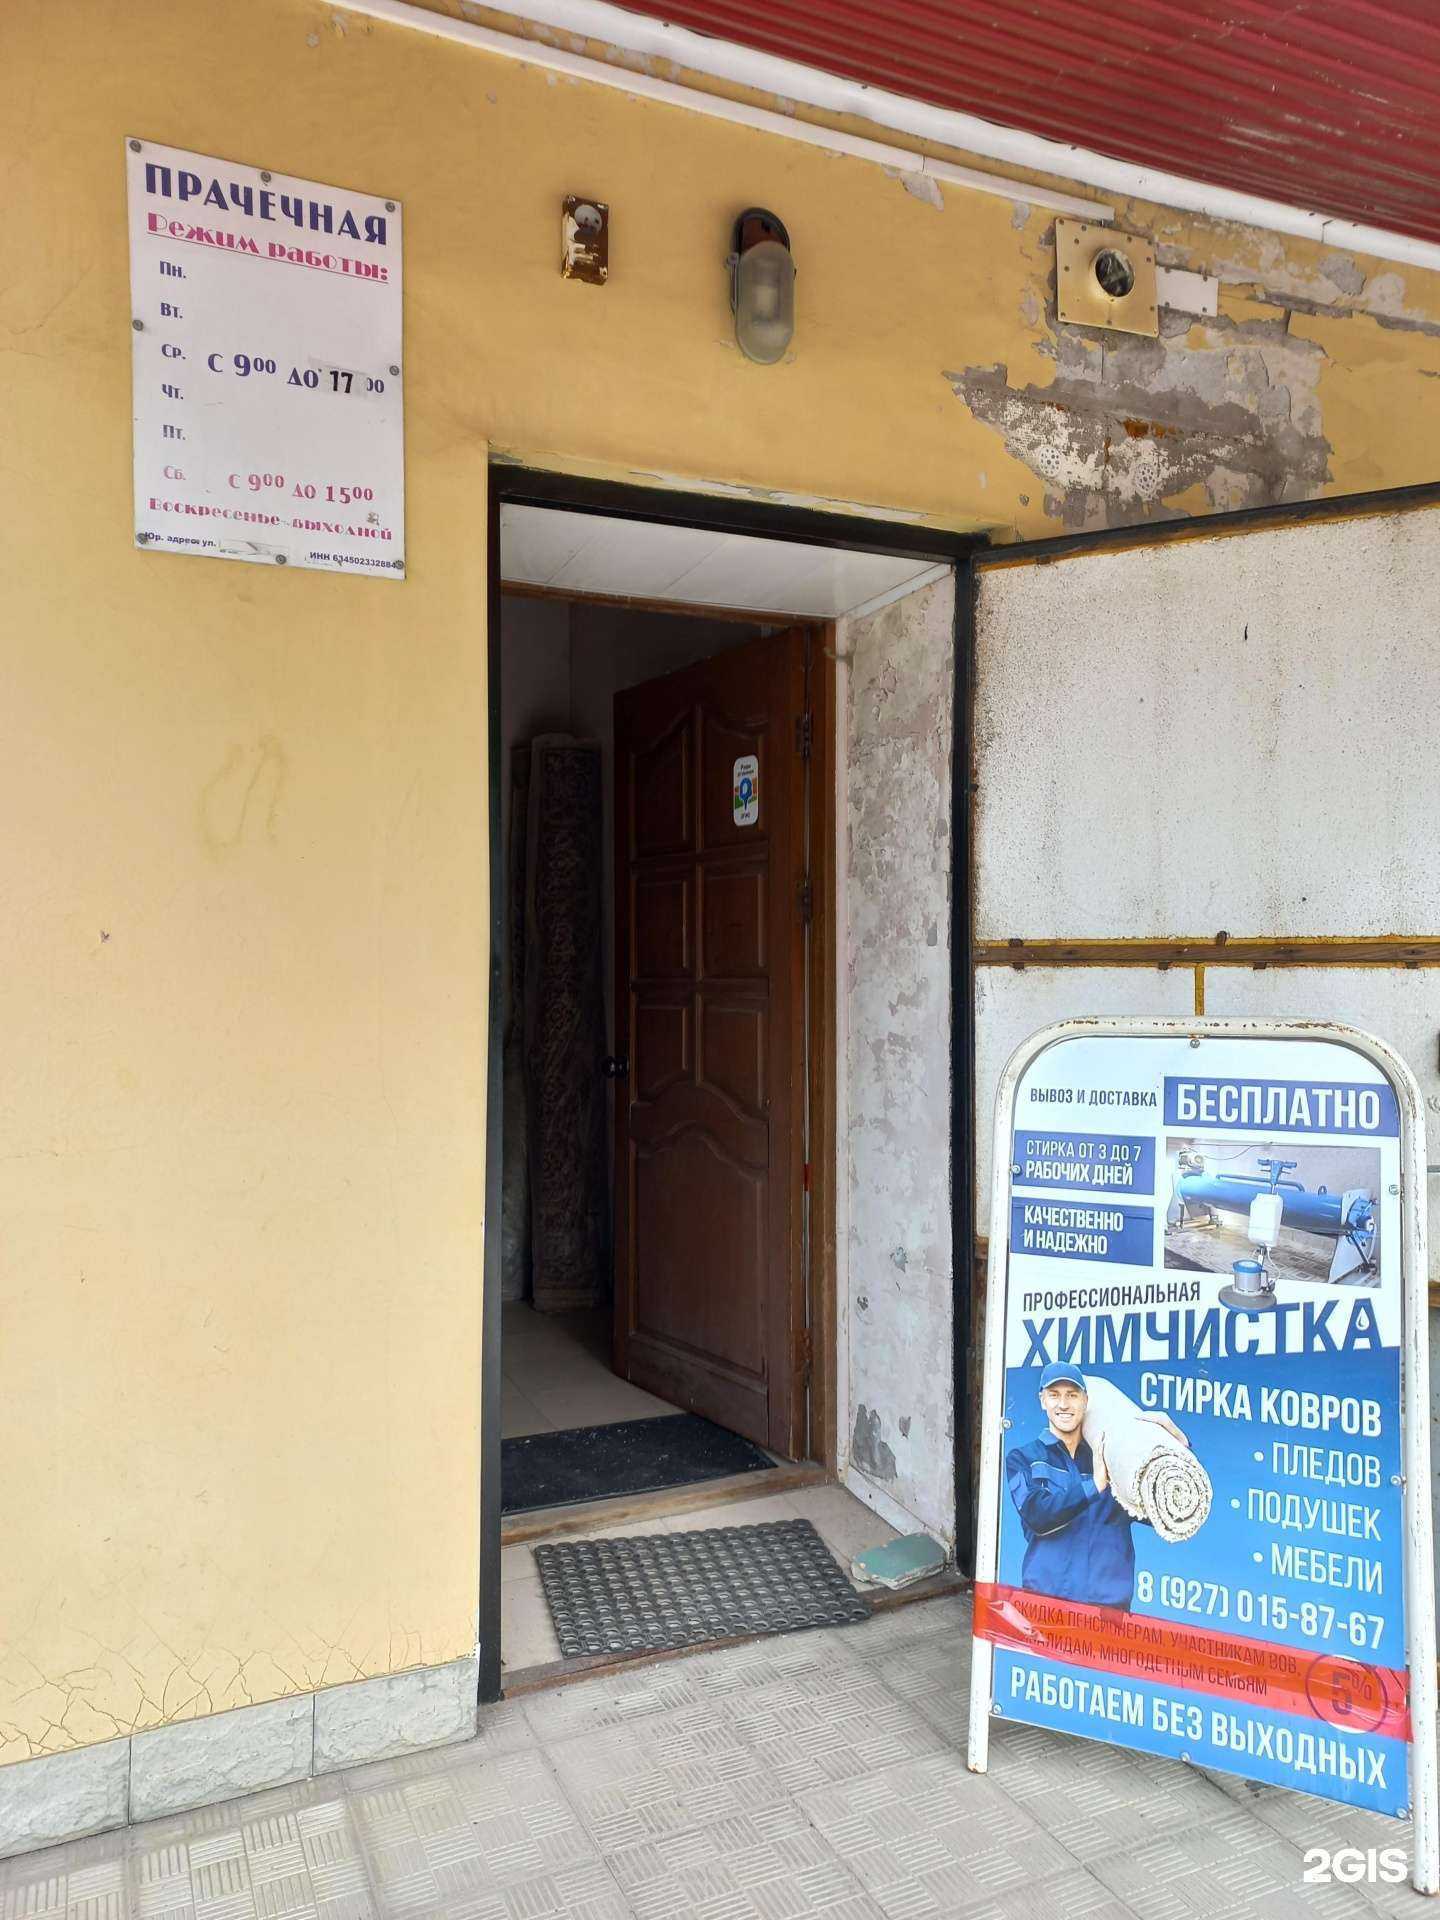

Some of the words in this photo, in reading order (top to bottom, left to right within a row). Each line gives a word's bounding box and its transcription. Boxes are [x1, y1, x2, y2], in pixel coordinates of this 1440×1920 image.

[145, 162, 388, 246] ПРАЧЕЧНАЯ
[147, 212, 260, 254] Режим
[268, 241, 389, 281] работы:
[159, 260, 187, 279] Пн.
[160, 302, 184, 319] Вт.
[161, 343, 187, 360] Ср.
[286, 367, 319, 388] ДО
[161, 383, 184, 400] Чт.
[162, 424, 187, 441] Пт.
[163, 465, 187, 481] Сб.
[291, 484, 316, 500] ДО
[149, 498, 281, 526] Воскресенье
[291, 518, 393, 541] выходной
[309, 552, 331, 561] ИНН
[1030, 1088, 1073, 1104] ВЫВОЗ
[1077, 1089, 1086, 1103] И
[1088, 1090, 1158, 1107] ДОСТАВКА
[1176, 1082, 1381, 1130] БЕСПЛАТНО
[1025, 1160, 1090, 1183] РАБОЧИХ
[1091, 1163, 1133, 1186] ДНЕЙ
[1026, 1139, 1075, 1157] СТИРКА
[1079, 1142, 1094, 1158] ОТ
[1098, 1144, 1106, 1159] 3
[1110, 1145, 1130, 1162] ДО
[1133, 1145, 1142, 1161] 7
[1024, 1205, 1124, 1232] КАЧЕСТВЕННО
[1023, 1229, 1034, 1248] И
[1036, 1230, 1108, 1255] НАДЕЖНО
[1023, 1280, 1201, 1313] ПРОФЕССИОНАЛЬНАЯ
[1021, 1297, 1384, 1368] ХИМЧИСТКА
[1140, 1372, 1253, 1422] СТИРКА
[1260, 1386, 1382, 1438] КОВРОВ
[1272, 1441, 1382, 1489] ПЛЕДОВ
[1247, 1488, 1382, 1542] ПОДУШЕК
[1271, 1542, 1383, 1595] МЕБЕЛИ
[1137, 1570, 1155, 1603] 8
[1160, 1574, 1229, 1618] (927)
[1236, 1588, 1385, 1650] 015-87-67
[1013, 1600, 1064, 1625] СКИДКА
[1171, 1632, 1266, 1668] УЧАСТНИКАМ
[1100, 1645, 1204, 1682] МНОГОДЕТНЫМ
[1208, 1667, 1267, 1696] СЕМЬЯМ
[1331, 1669, 1372, 1716] 5%
[1010, 1665, 1144, 1727] РАБОТАЕМ
[1152, 1698, 1203, 1741] БЕЗ
[1211, 1721, 1388, 1789] ВЫХОДНЫХ
